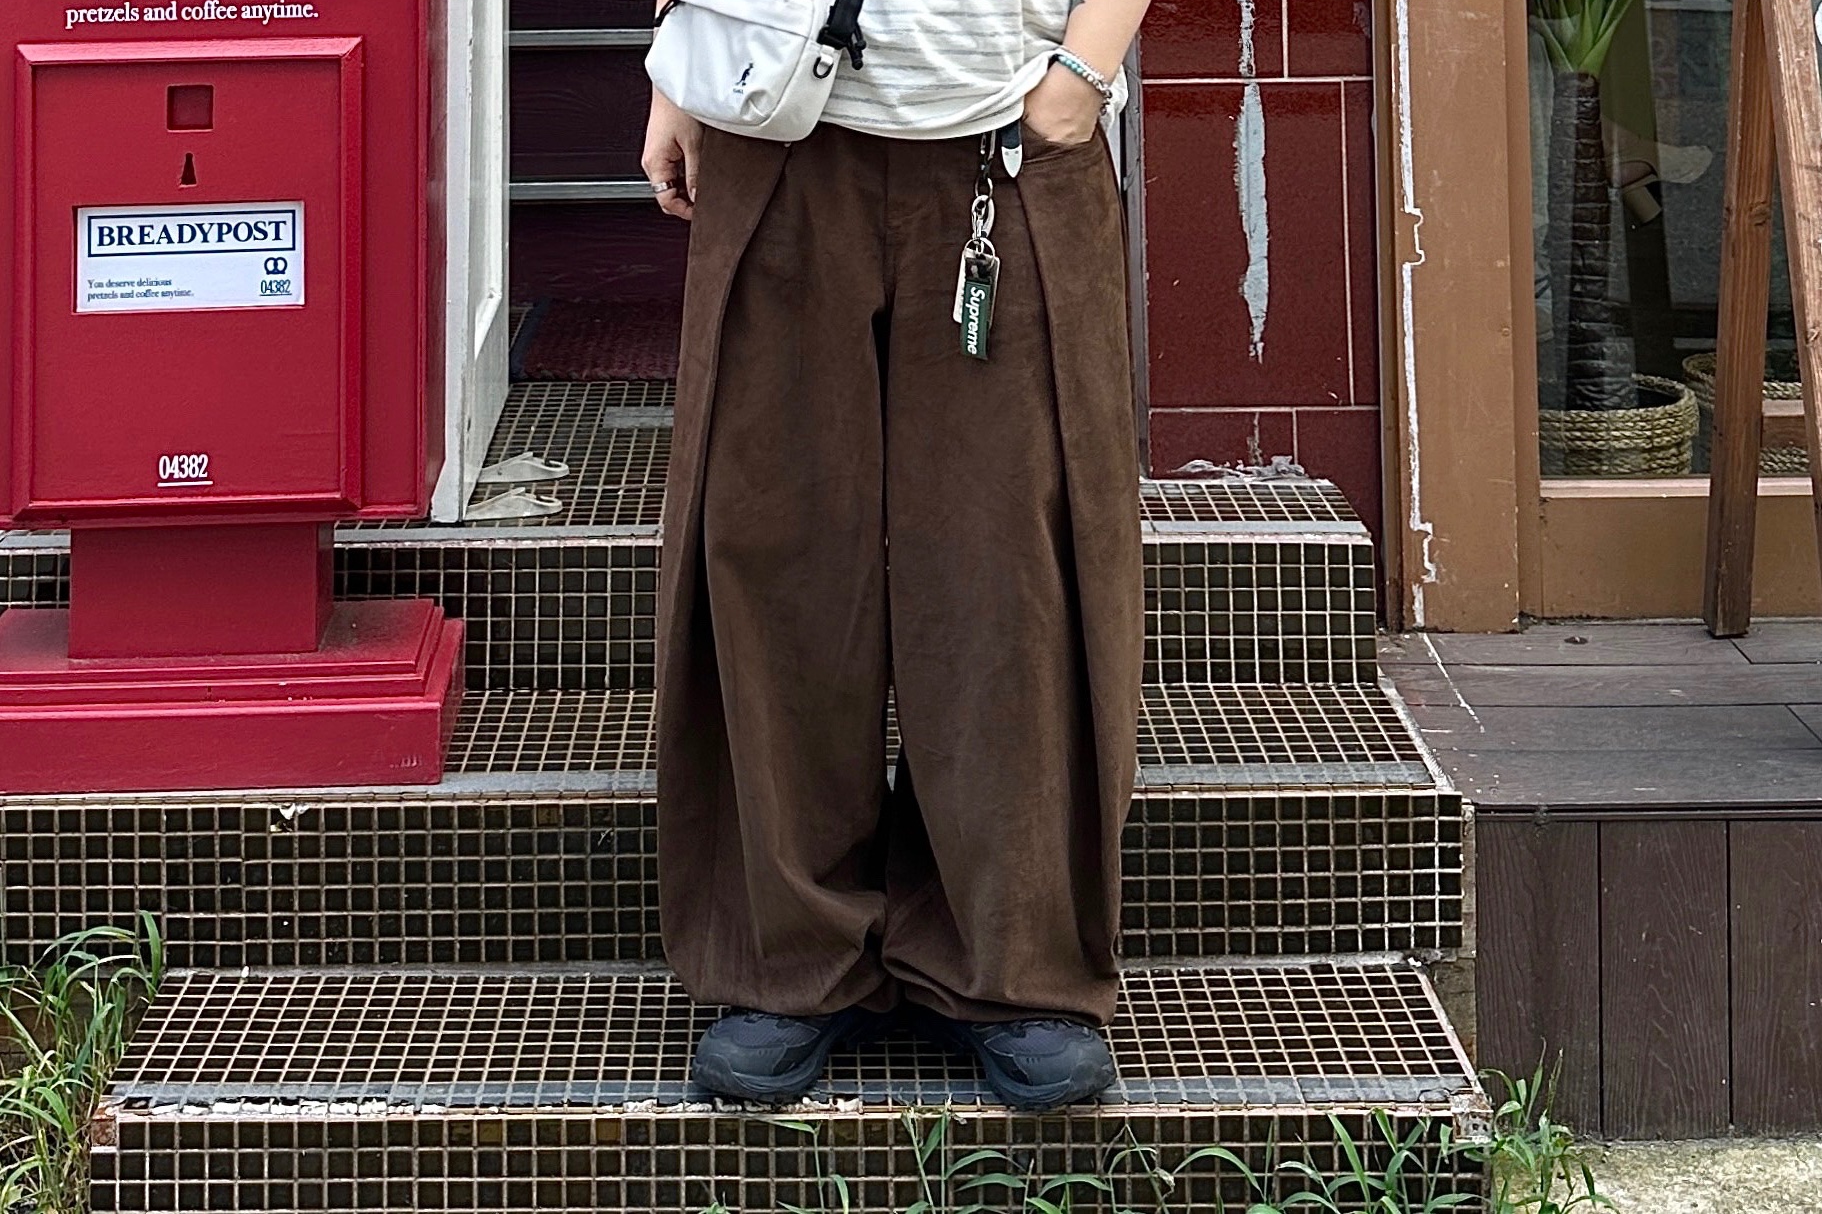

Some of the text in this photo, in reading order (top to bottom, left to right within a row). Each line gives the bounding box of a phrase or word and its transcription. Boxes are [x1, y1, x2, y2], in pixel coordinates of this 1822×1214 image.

[65, 0, 320, 29] pretzels and coffee anytime.
[97, 220, 287, 247] BREADYPOST
[106, 278, 136, 288] deserve
[137, 277, 173, 287] delicious
[120, 291, 135, 299] and
[136, 289, 160, 299] coffee
[260, 280, 292, 294] 04382
[965, 286, 986, 355] Supreme
[159, 454, 209, 480] 04382
